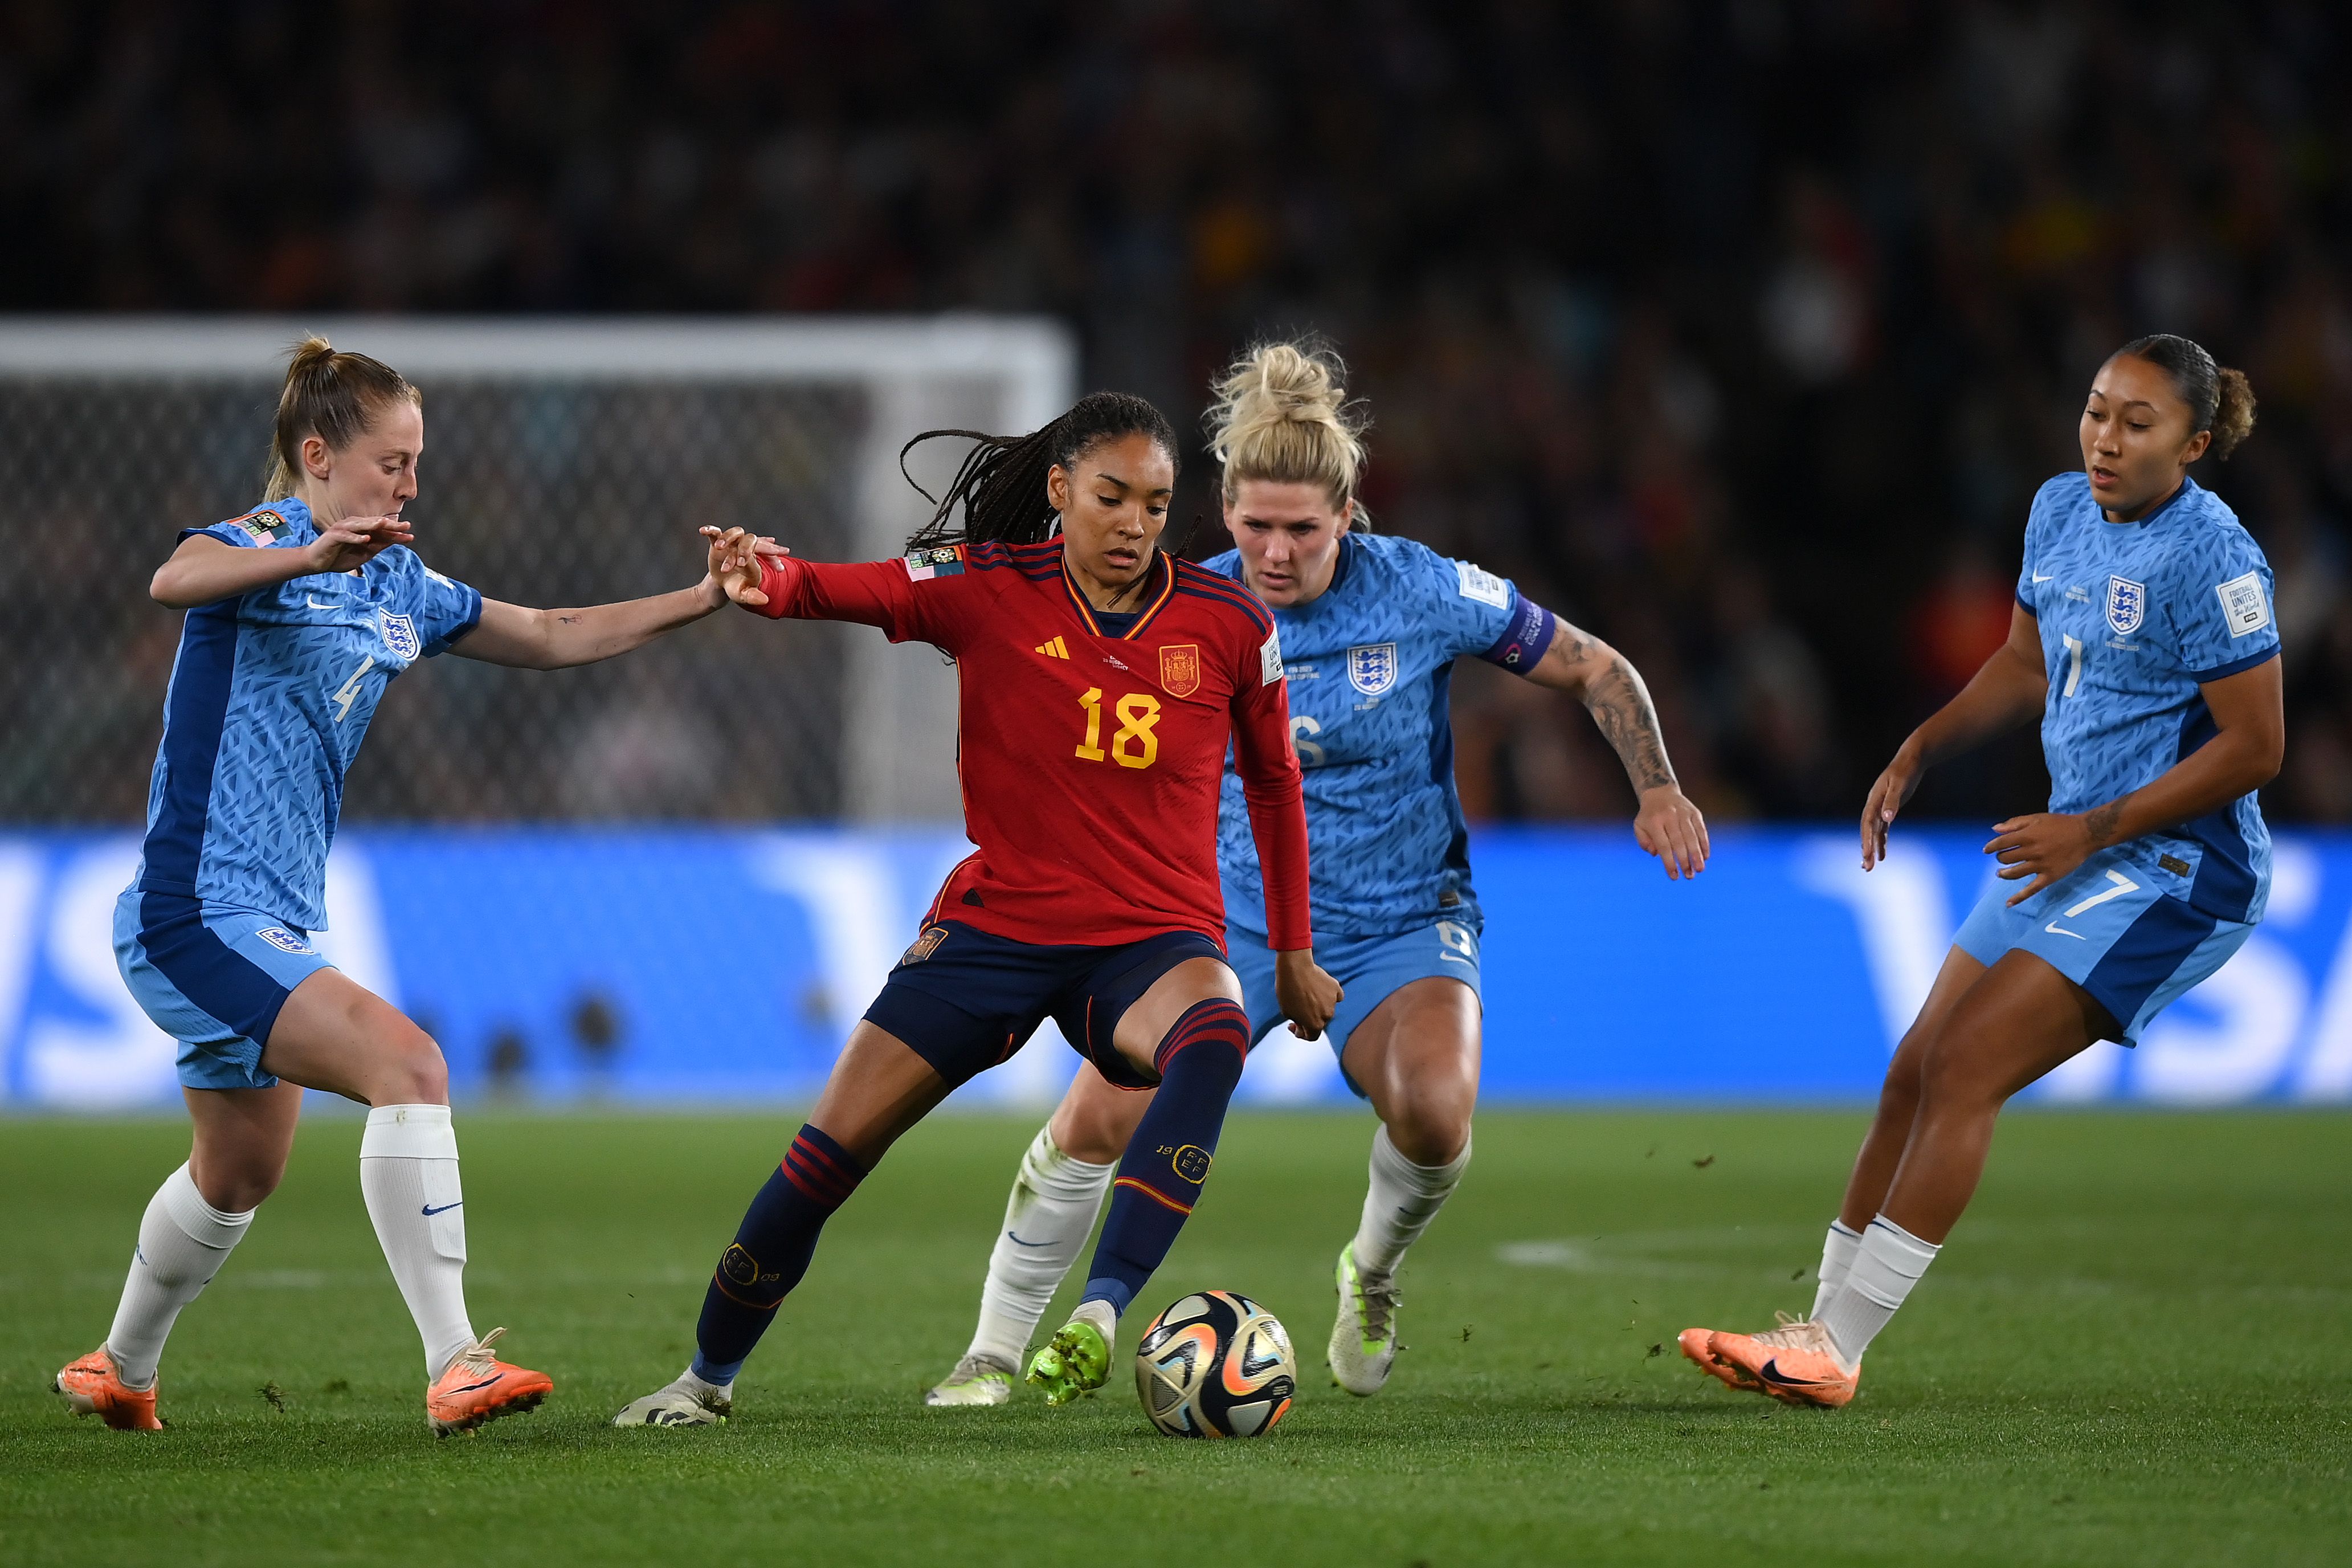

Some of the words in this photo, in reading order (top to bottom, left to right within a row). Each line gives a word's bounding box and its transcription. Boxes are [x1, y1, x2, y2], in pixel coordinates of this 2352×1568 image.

[2232, 590, 2257, 607] UNITES
[332, 655, 374, 722] 4
[1075, 687, 1161, 769] 18
[1289, 716, 1325, 767] 6
[2063, 869, 2141, 918] 7
[1156, 1145, 1173, 1155] 19
